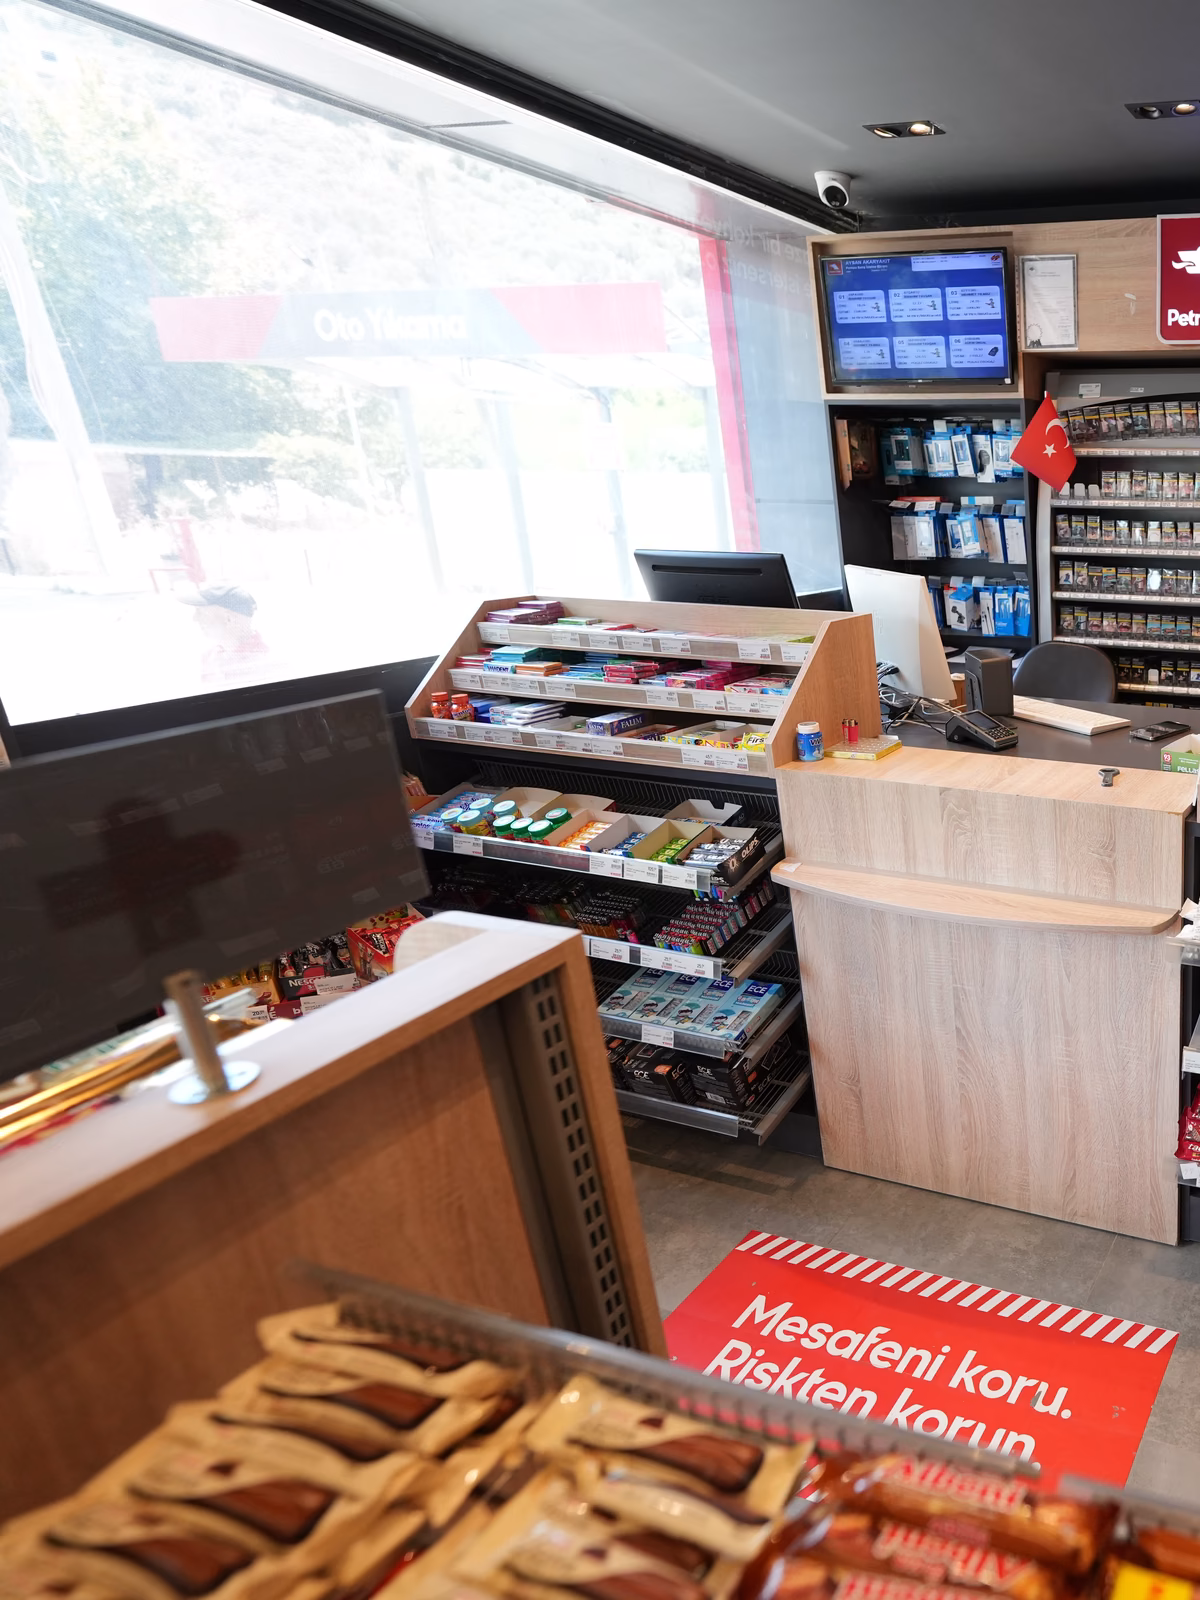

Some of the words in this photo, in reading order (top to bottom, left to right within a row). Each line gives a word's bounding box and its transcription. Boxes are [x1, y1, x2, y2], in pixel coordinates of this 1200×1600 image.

[313, 308, 365, 341] Oto
[364, 305, 467, 340] Yıkama
[620, 717, 642, 729] FALIM
[747, 737, 767, 745] Firs
[742, 837, 759, 858] OLIPS
[680, 974, 698, 983] ECE
[713, 980, 733, 989] ECE
[748, 985, 768, 995] ECE
[732, 1294, 951, 1382] Mesafeni
[948, 1349, 1072, 1419] koru.
[702, 1339, 878, 1415] Riskten
[882, 1388, 1042, 1470] korun.
